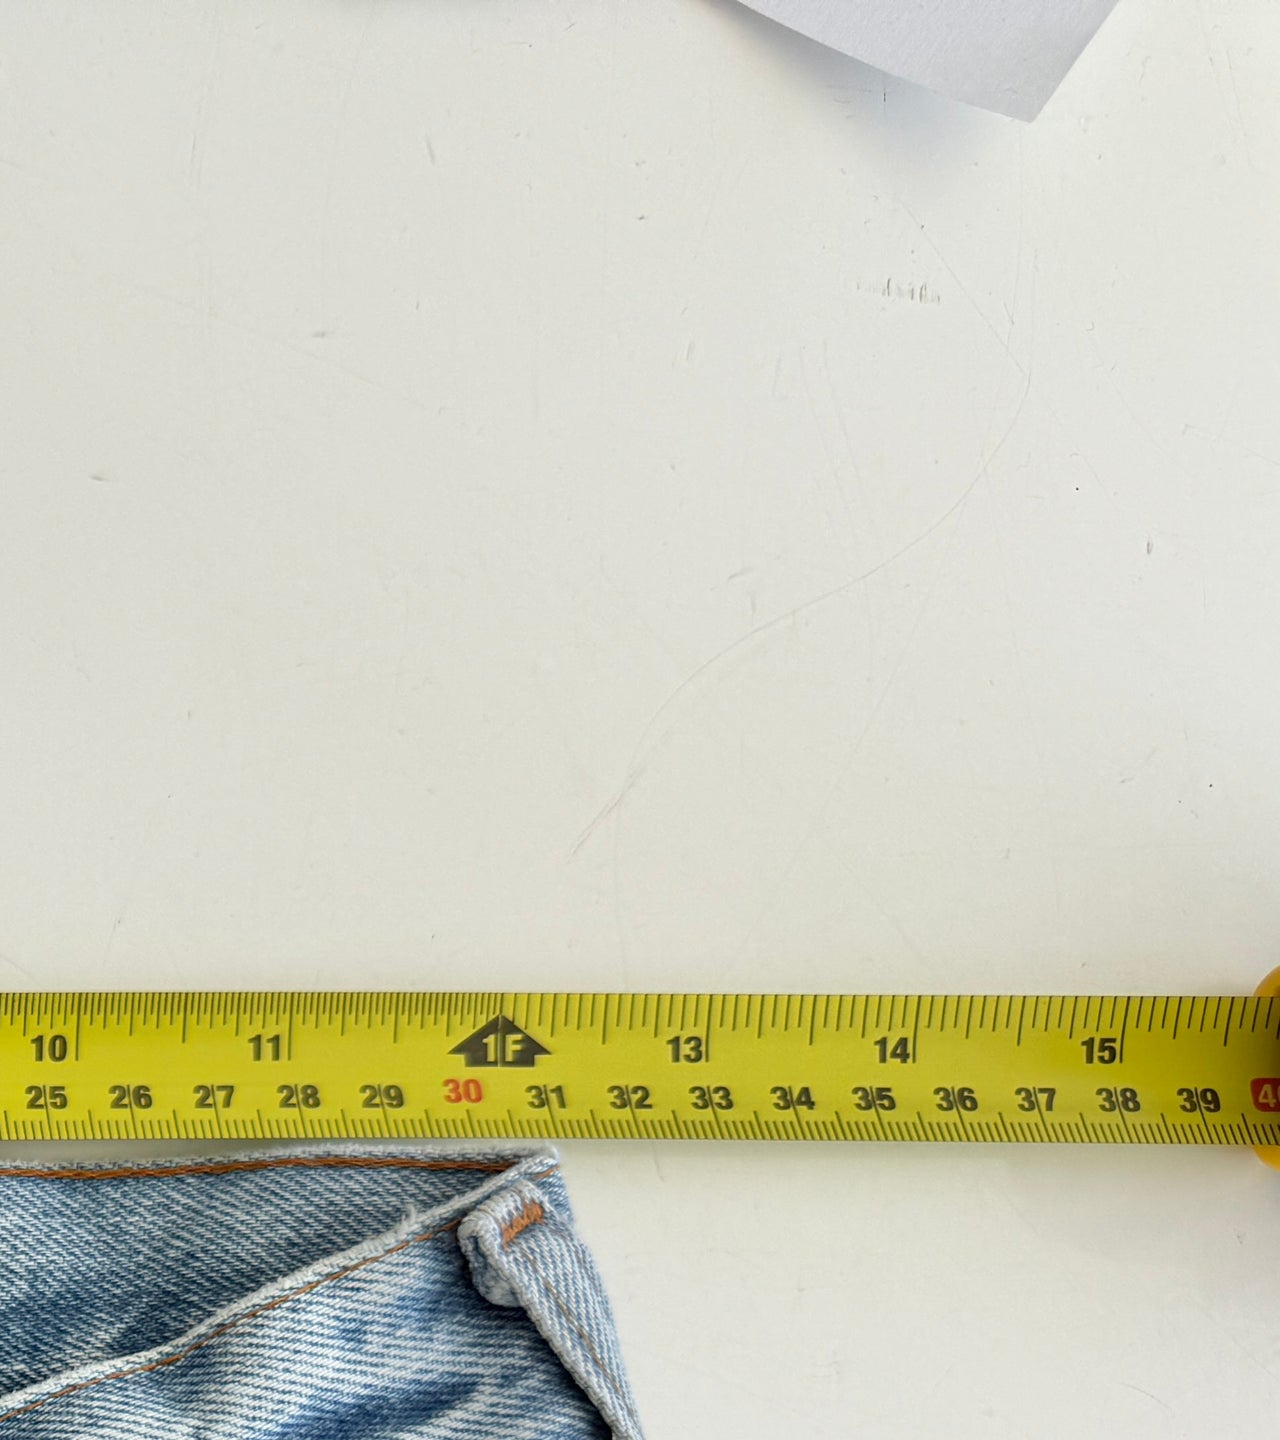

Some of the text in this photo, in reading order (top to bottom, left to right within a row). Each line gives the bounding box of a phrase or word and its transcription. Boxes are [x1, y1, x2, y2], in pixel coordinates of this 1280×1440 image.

[30, 1034, 68, 1062] 10
[247, 1034, 281, 1062] 11
[481, 1033, 525, 1063] 1F
[666, 1036, 703, 1063] 13
[873, 1037, 910, 1064] 14
[1081, 1037, 1117, 1064] 15
[24, 1086, 68, 1110] 25
[108, 1085, 153, 1110] 26
[192, 1085, 235, 1109] 27
[276, 1085, 321, 1109] 28
[359, 1085, 404, 1109] 29
[442, 1079, 483, 1104] 30
[524, 1085, 567, 1109] 31
[606, 1085, 653, 1110] 32
[688, 1086, 734, 1110] 33
[770, 1086, 816, 1110] 34
[851, 1087, 896, 1111] 35
[933, 1087, 978, 1112] 36
[1014, 1087, 1057, 1112] 37
[1095, 1087, 1141, 1112] 38
[1176, 1087, 1221, 1112] 39
[1258, 1084, 1280, 1107] 4
